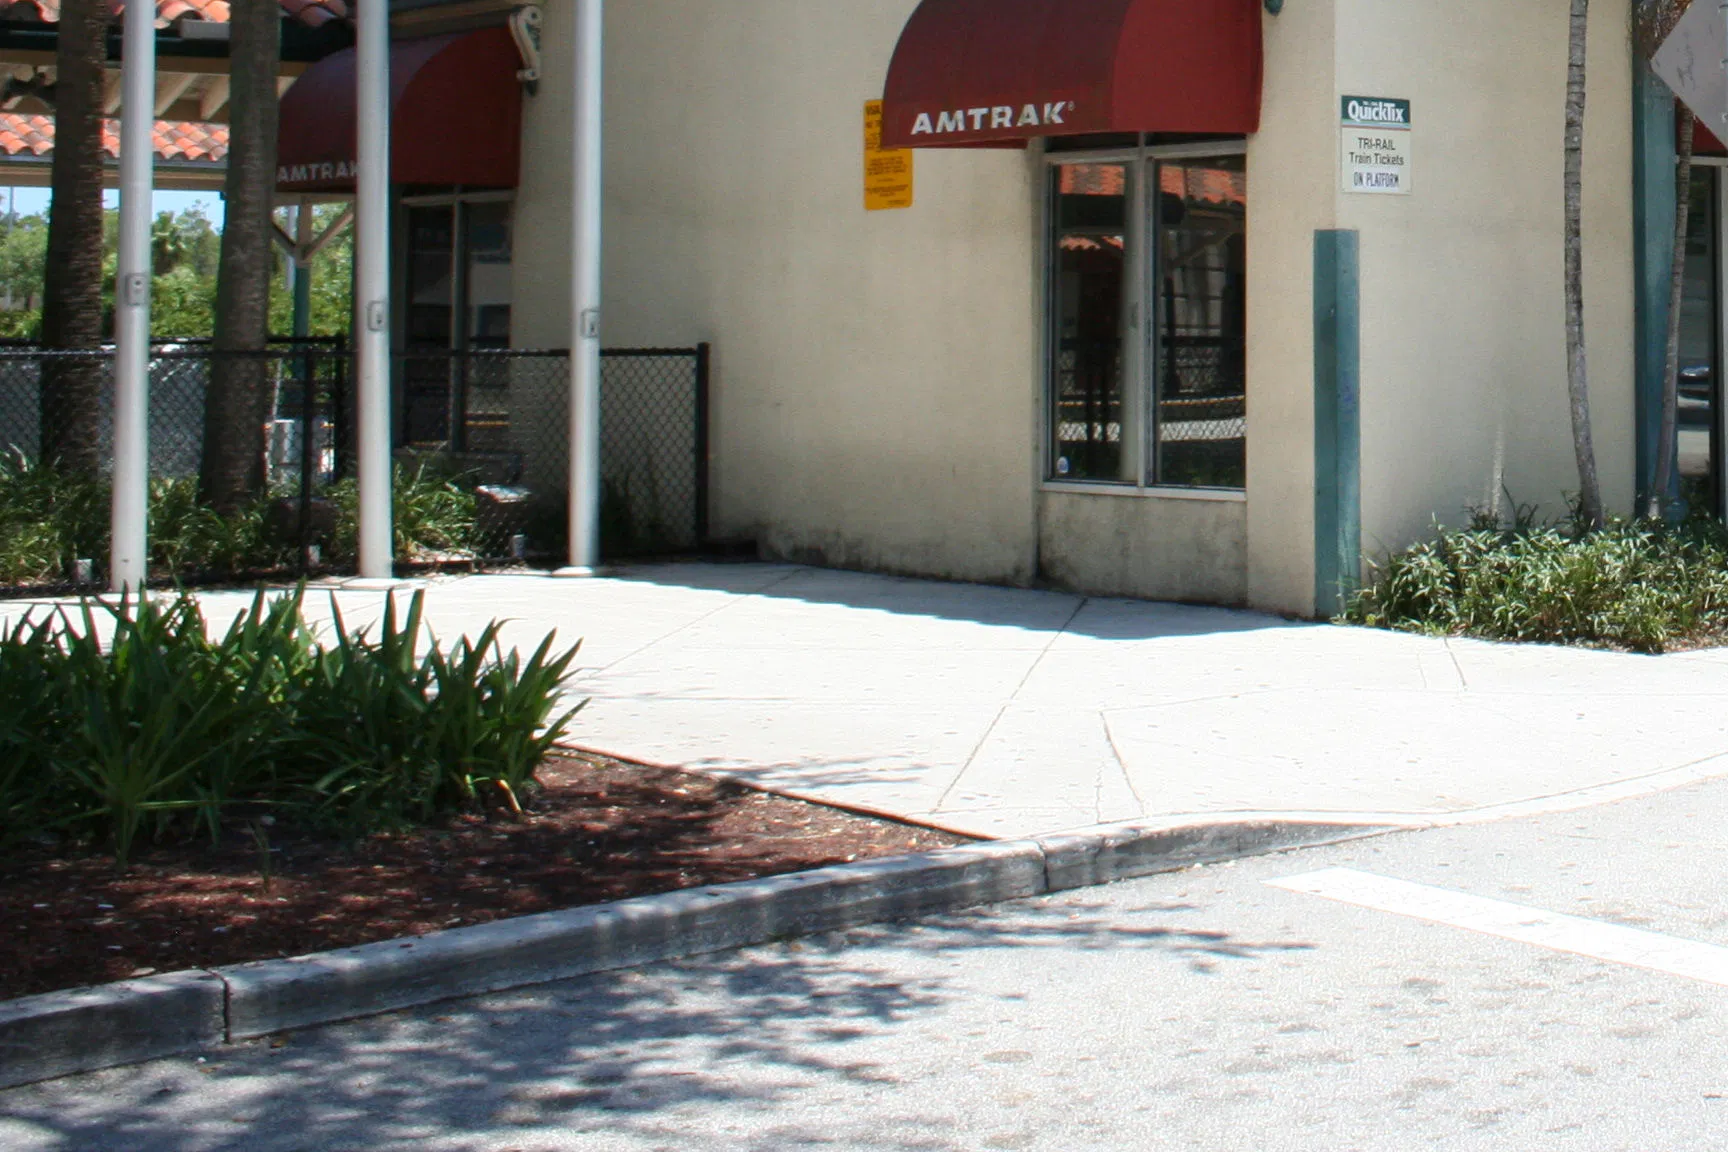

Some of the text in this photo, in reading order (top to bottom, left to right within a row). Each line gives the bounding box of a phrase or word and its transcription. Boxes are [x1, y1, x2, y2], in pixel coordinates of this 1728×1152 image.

[910, 100, 1067, 136] AMTRAK
[1347, 99, 1404, 123] QuickTix
[1358, 137, 1396, 150] TRI-RAIL
[1349, 152, 1404, 166] Train Tickets
